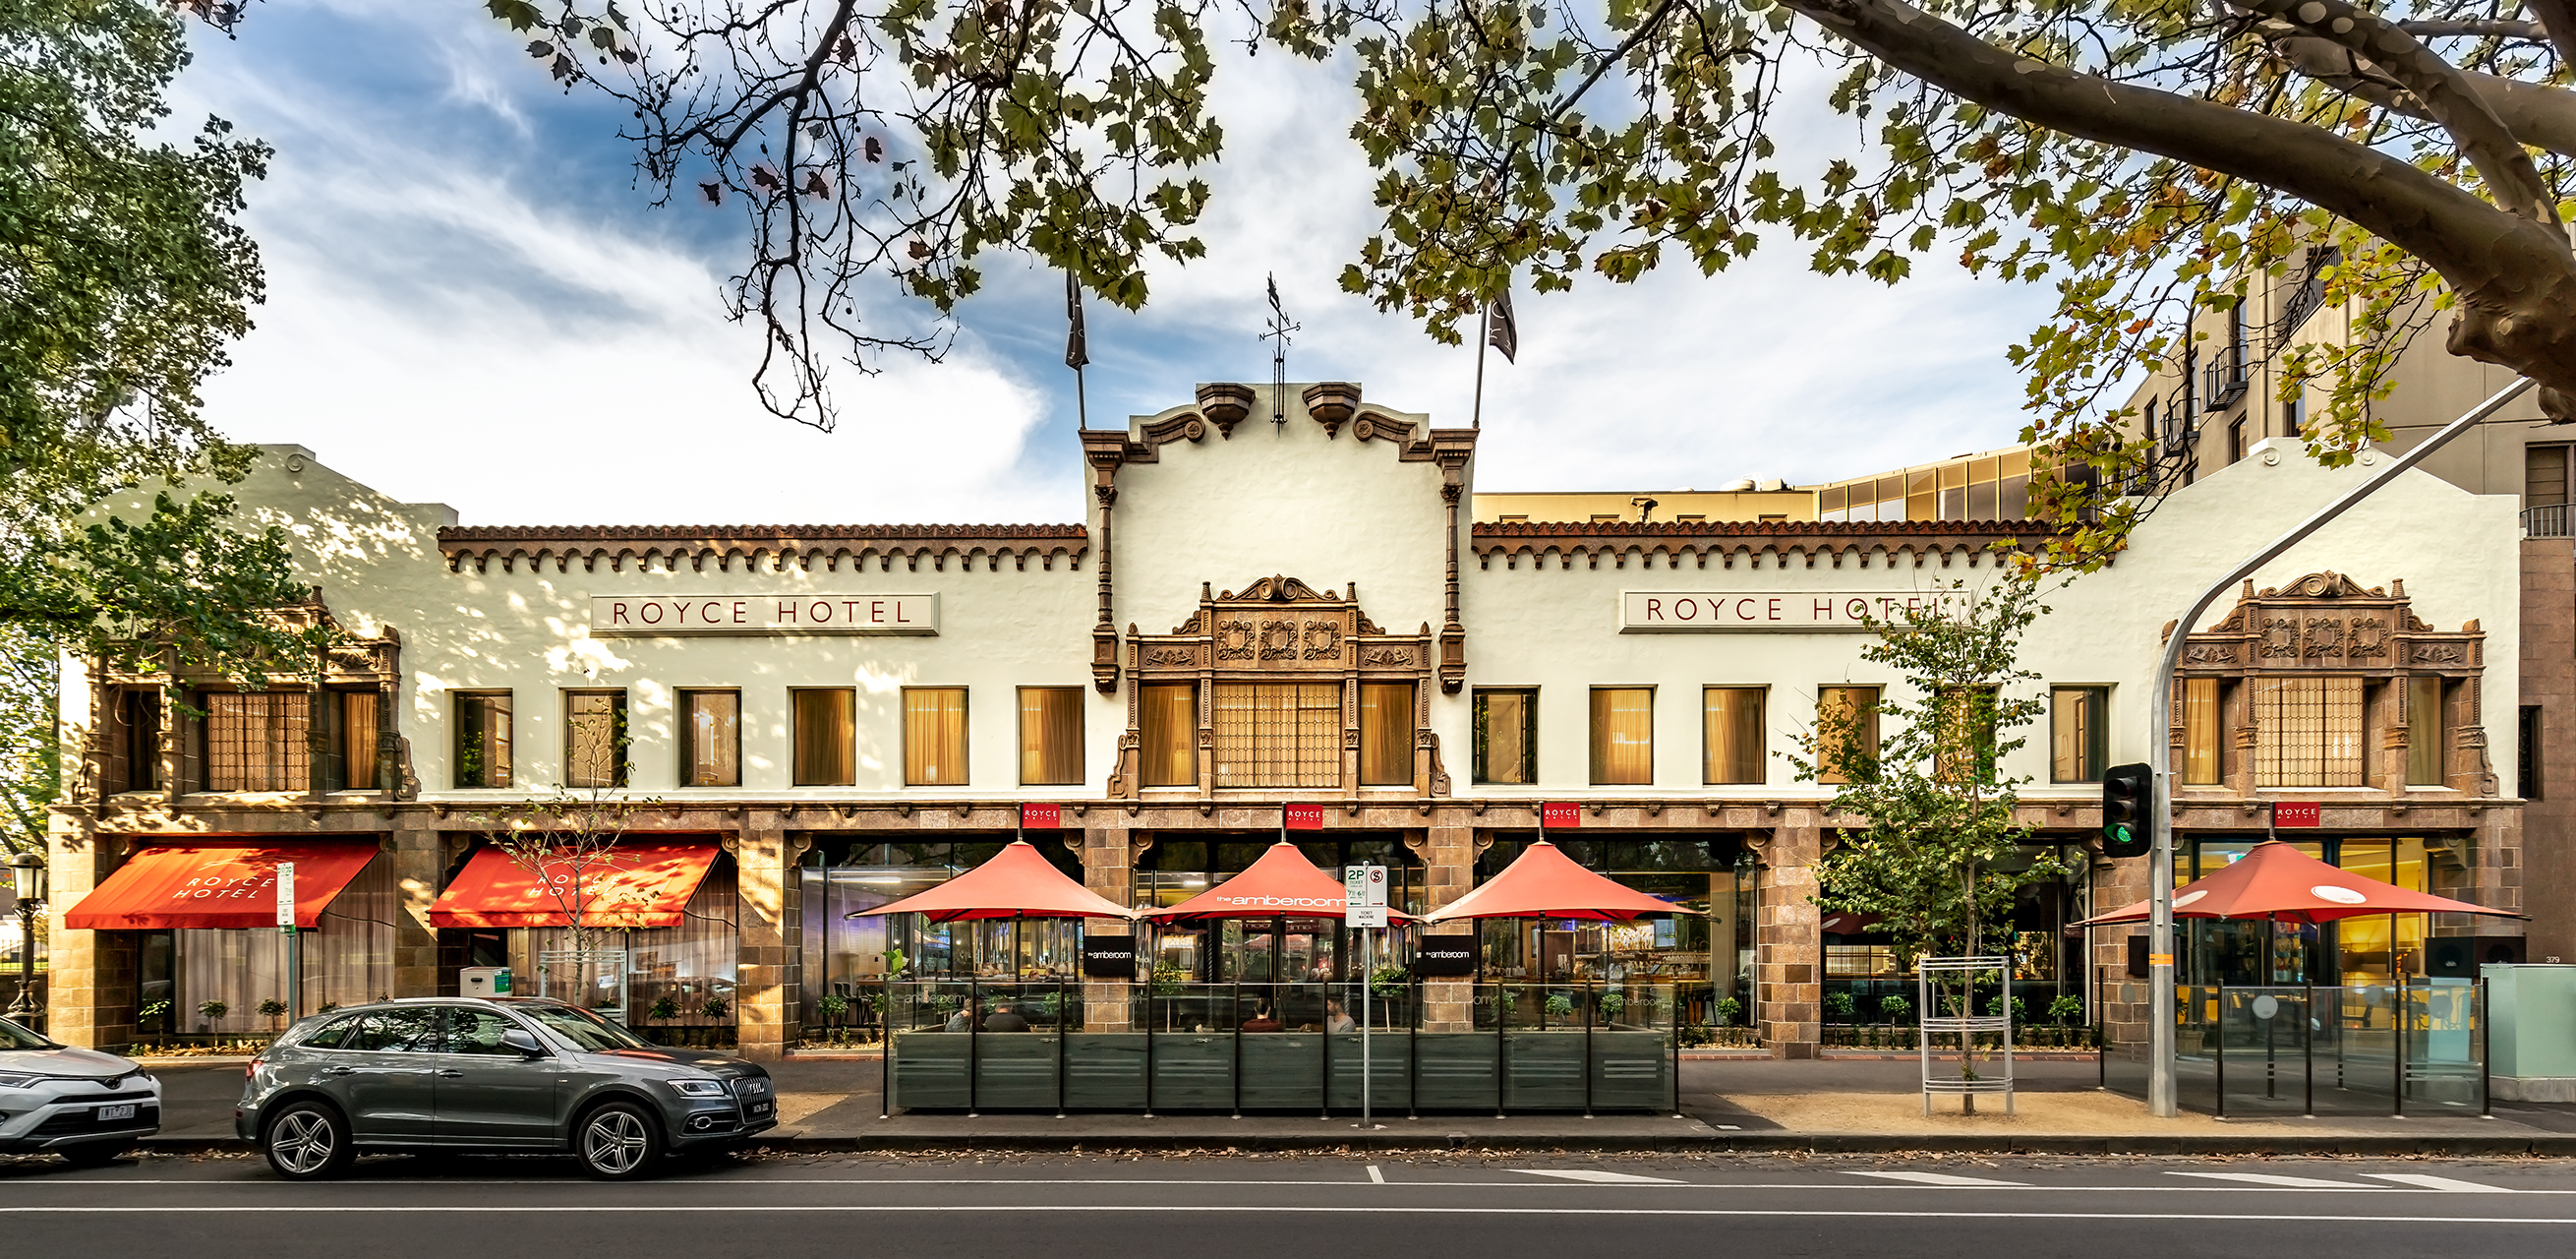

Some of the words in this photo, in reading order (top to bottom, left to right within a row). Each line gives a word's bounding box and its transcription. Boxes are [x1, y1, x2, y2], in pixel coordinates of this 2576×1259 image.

[614, 601, 746, 625] ROYCE
[778, 601, 910, 624] HOTEL
[1647, 598, 1782, 621] ROYCE
[1813, 598, 1948, 621] HOTEL
[1348, 869, 1365, 879] 2P
[186, 876, 275, 887] ROYCE
[172, 889, 259, 899] HOTEL
[1231, 895, 1347, 907] amberoom
[1092, 950, 1132, 959] amberoom
[1431, 949, 1470, 959] amberoom
[2547, 955, 2560, 964] 379
